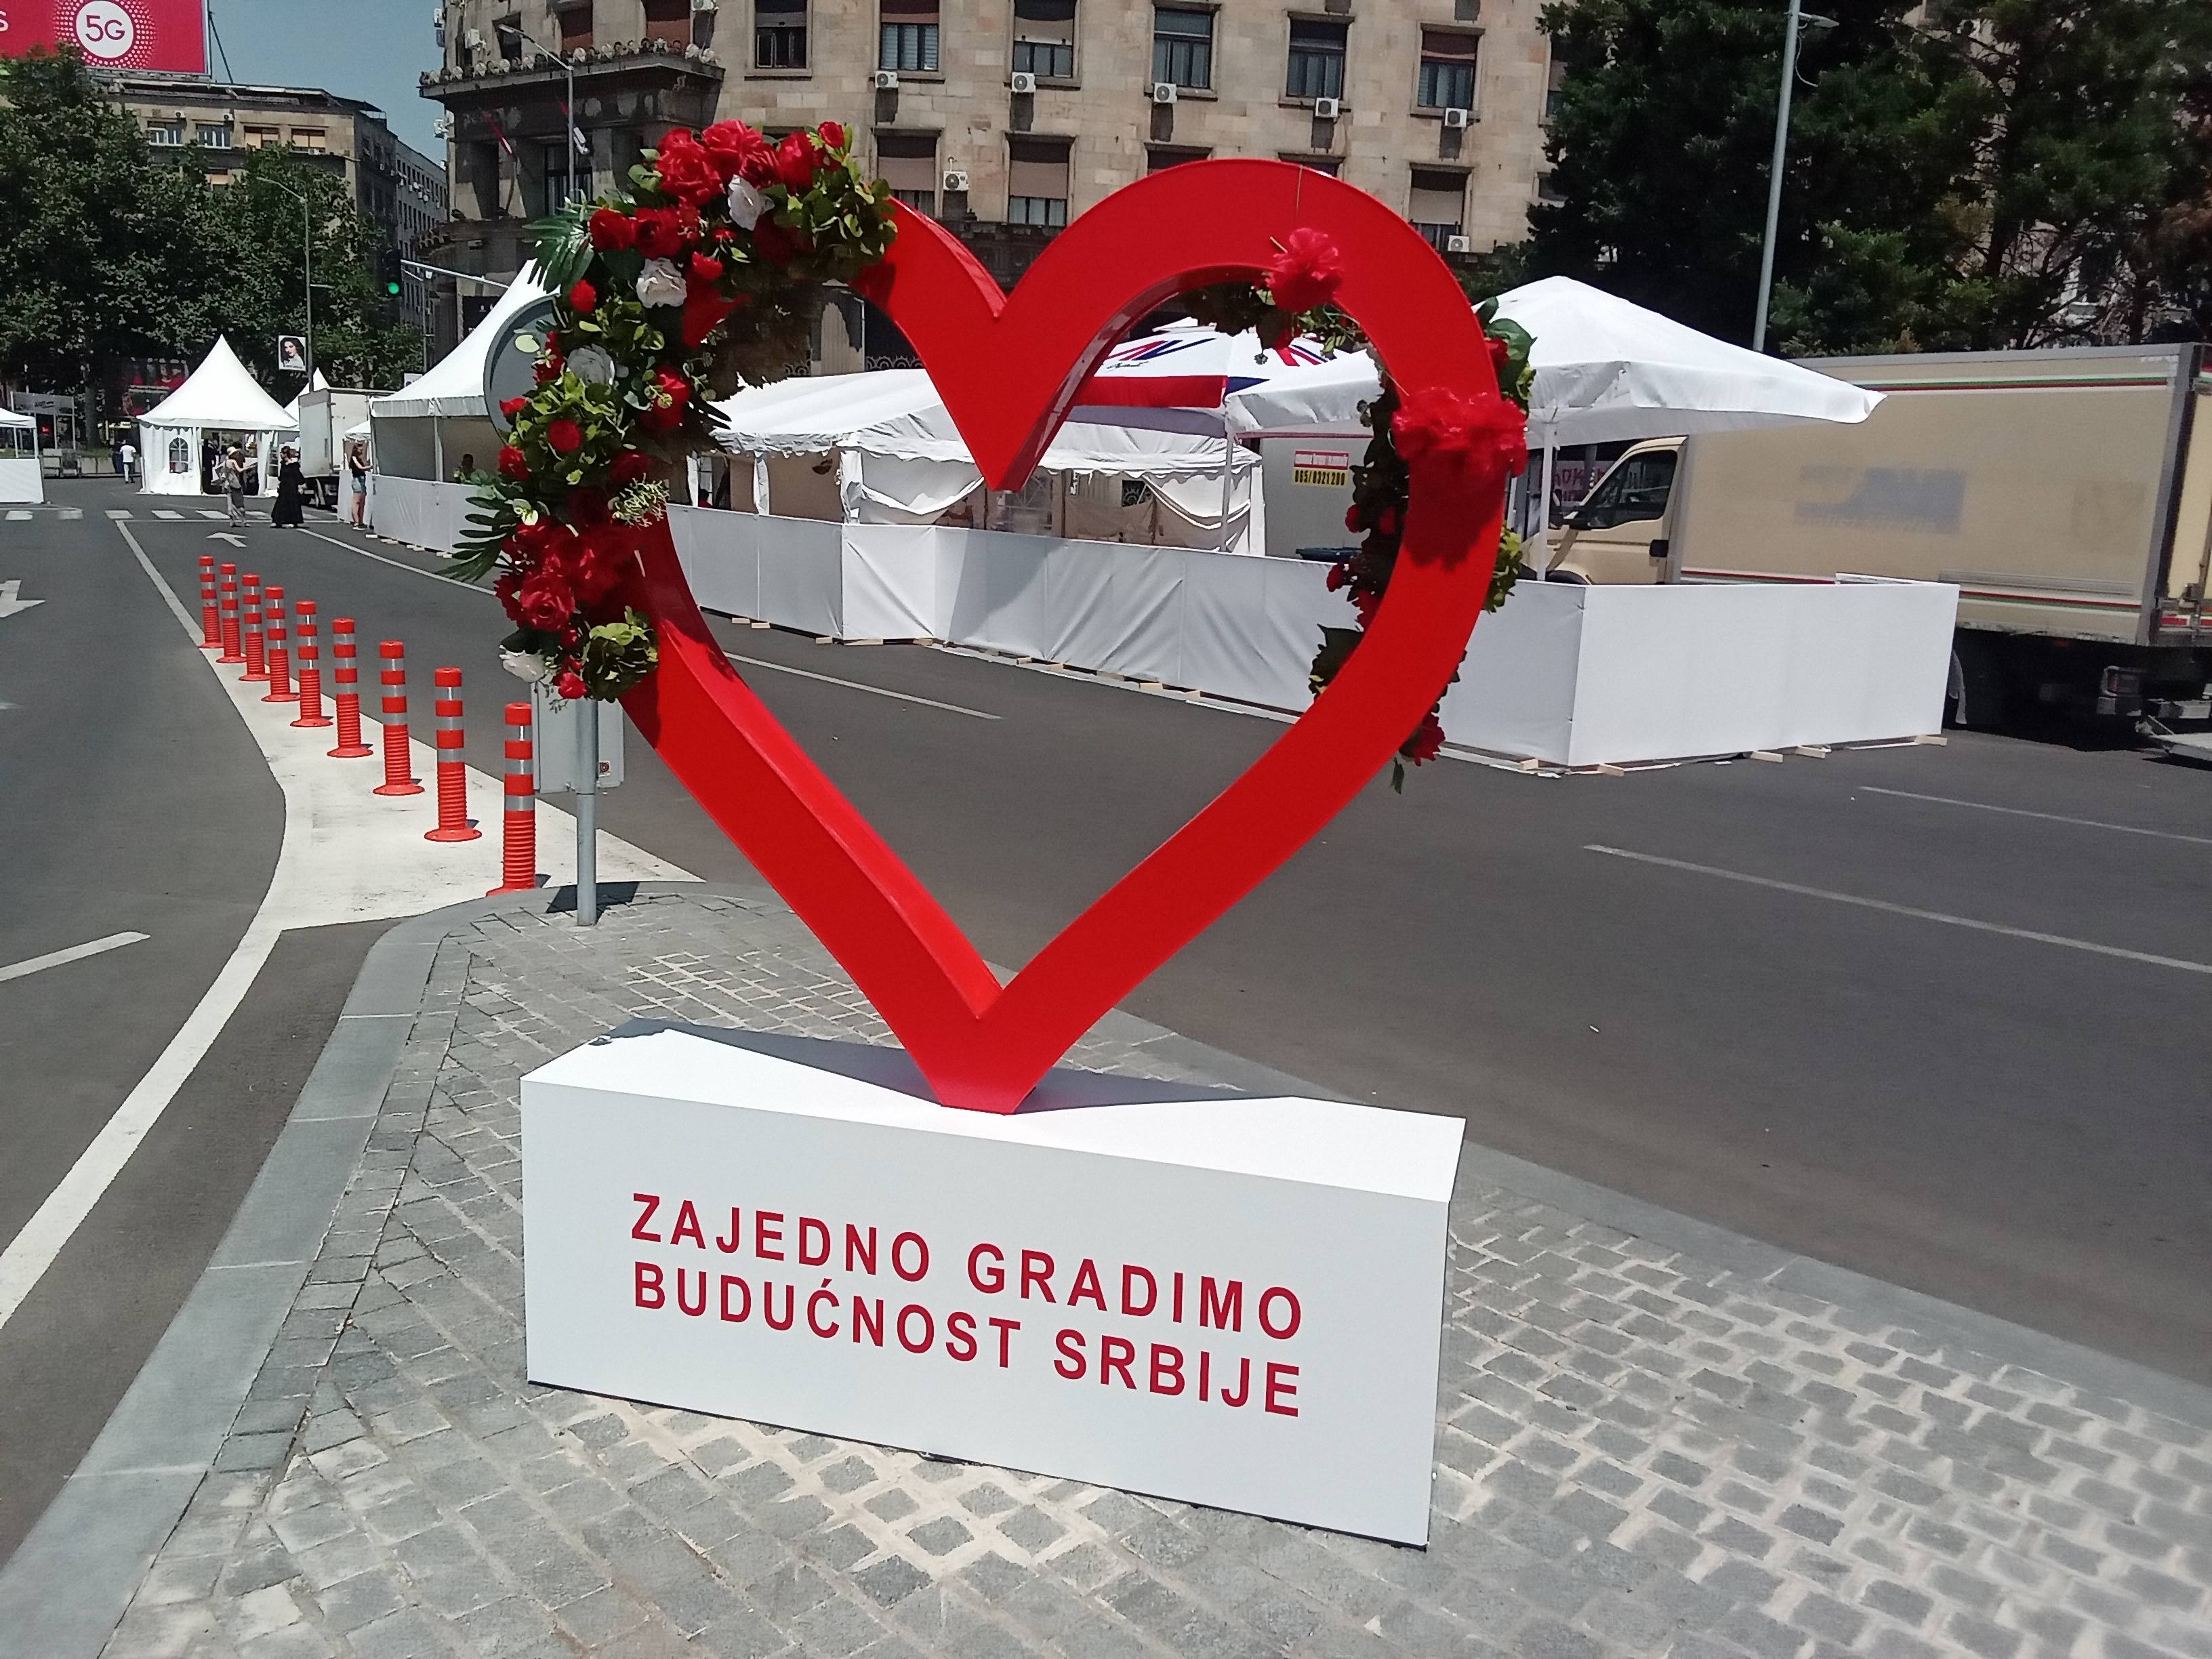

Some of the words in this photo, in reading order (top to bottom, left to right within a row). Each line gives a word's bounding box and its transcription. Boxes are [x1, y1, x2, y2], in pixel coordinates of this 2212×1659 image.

[85, 14, 125, 42] 5G
[632, 1193, 929, 1282] ZAJEDNO
[967, 1243, 1301, 1340] GRADIMO
[635, 1261, 1021, 1368] BUDUĆNOST
[1054, 1329, 1299, 1417] SRBIJE
